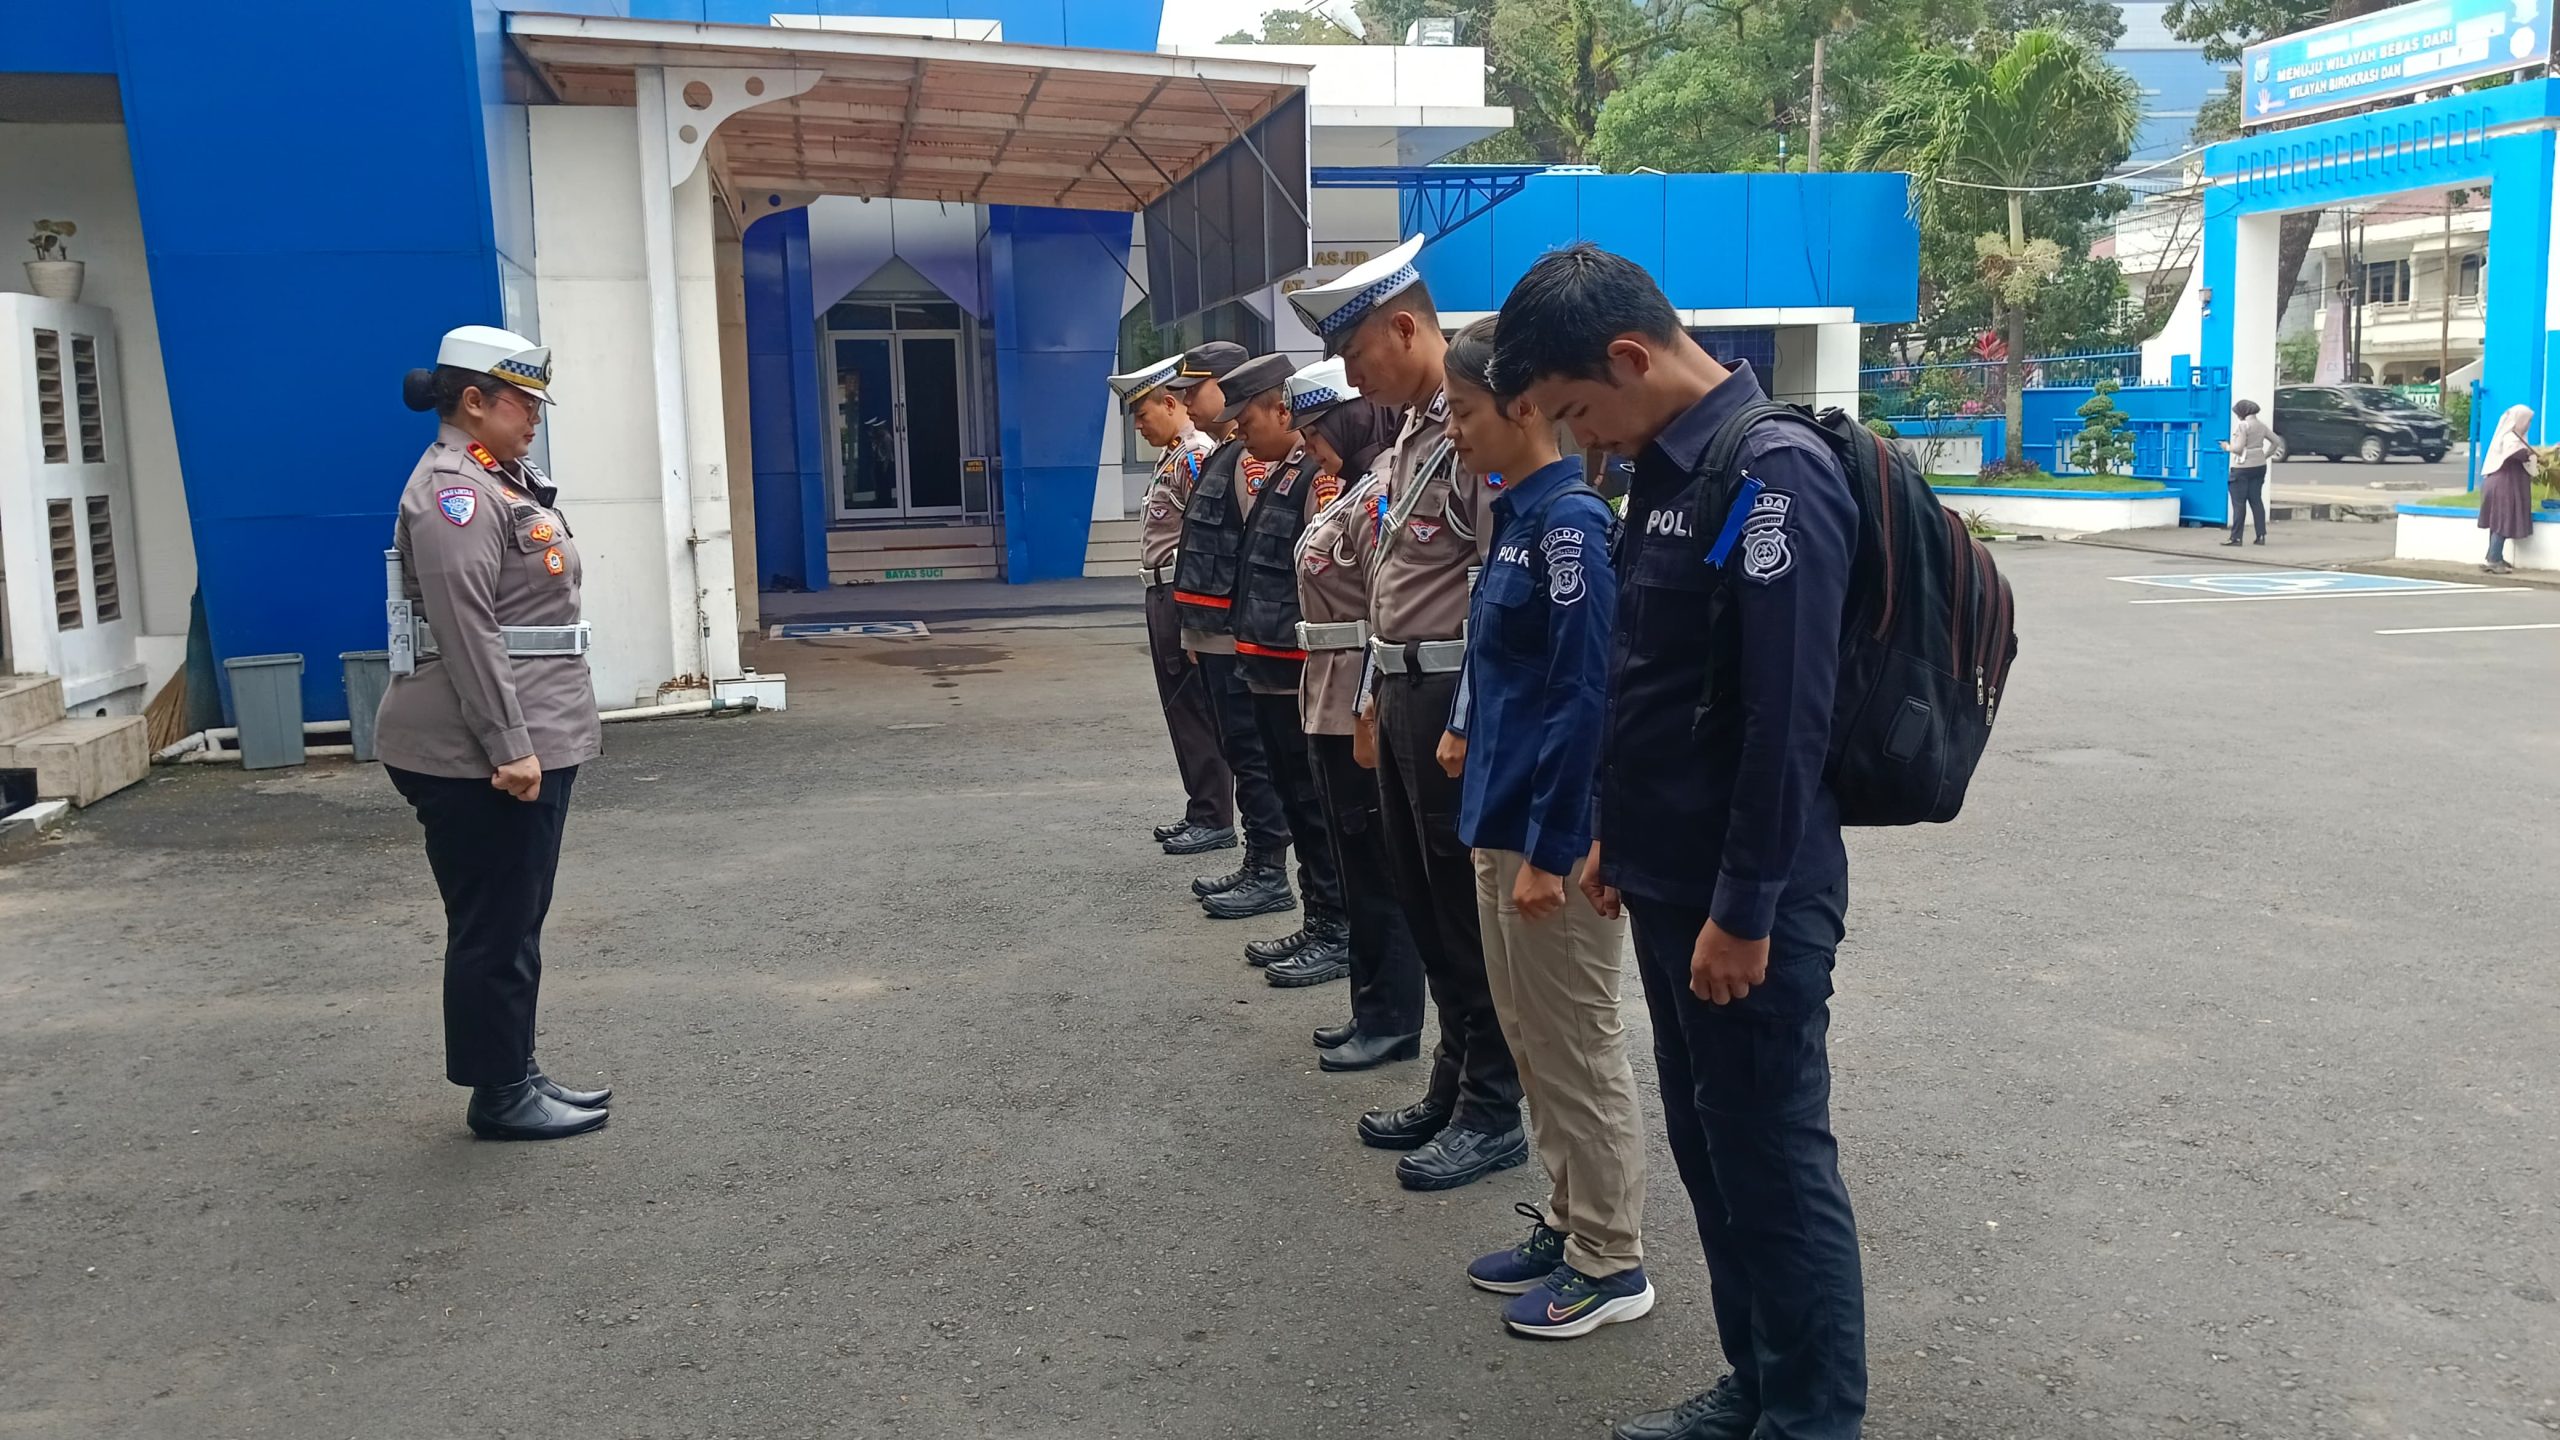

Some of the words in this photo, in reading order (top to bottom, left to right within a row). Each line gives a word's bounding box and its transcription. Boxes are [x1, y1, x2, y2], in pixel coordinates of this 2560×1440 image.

[2276, 60, 2323, 83] MENUJU
[2326, 47, 2376, 71] WILAYAH
[2423, 29, 2453, 49] DARI
[2288, 79, 2327, 99] WILAYAH
[2328, 68, 2379, 92] BIROKRASI
[2381, 63, 2402, 80] DAN
[1314, 250, 1370, 266] ASJID
[1754, 496, 1785, 509] LDA
[1646, 509, 1693, 538] POL
[1543, 529, 1581, 550] POLDA
[884, 569, 917, 580] BATAS
[919, 567, 944, 578] SUCI
